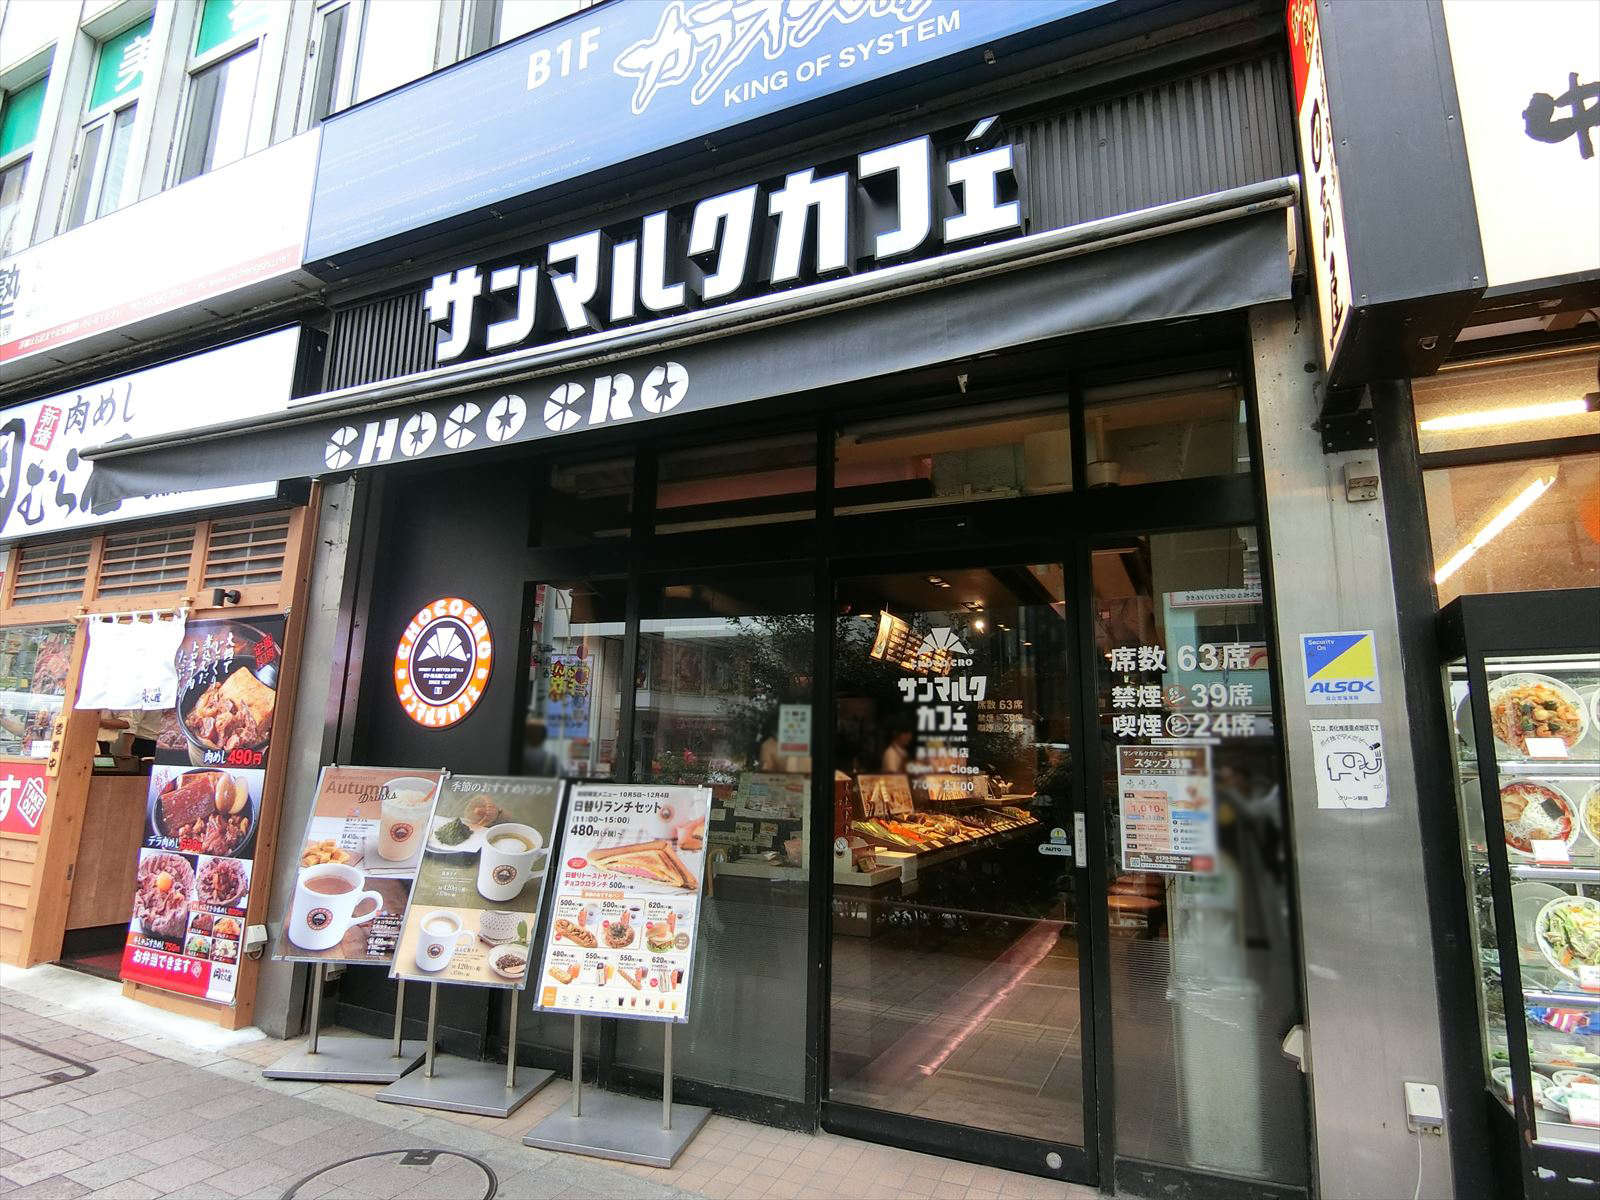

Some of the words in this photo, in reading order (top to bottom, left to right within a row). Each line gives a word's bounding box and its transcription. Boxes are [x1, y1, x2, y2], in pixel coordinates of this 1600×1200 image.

[526, 26, 602, 91] B1F
[723, 71, 788, 108] KING
[796, 54, 832, 82] OF
[839, 10, 961, 68] SYSTEM
[424, 115, 1022, 366] サンマルクカフェ
[64, 381, 137, 436] 肉めし
[325, 394, 527, 470] CHOCO
[543, 361, 690, 432] CRO
[1308, 638, 1335, 646] Security
[1110, 645, 1167, 673] 席数
[1177, 643, 1251, 671] 63席
[898, 676, 987, 701] サンマルク
[1112, 685, 1163, 708] 禁煙
[1191, 683, 1253, 707] 39席
[1310, 681, 1375, 693] ALSOK
[917, 704, 968, 731] カフェ
[1112, 714, 1163, 737] 喫煙
[1192, 713, 1255, 737] 24席
[203, 752, 226, 764] 肉めし
[227, 749, 262, 765] 490円
[949, 765, 980, 774] Close
[26, 783, 44, 810] TAKE
[325, 780, 390, 797] Autumn
[452, 781, 552, 795] 季節のおすすめドリンク
[22, 798, 38, 819] OUT
[573, 800, 661, 814] 日替りランチセット
[133, 949, 191, 973] お弁当できます
